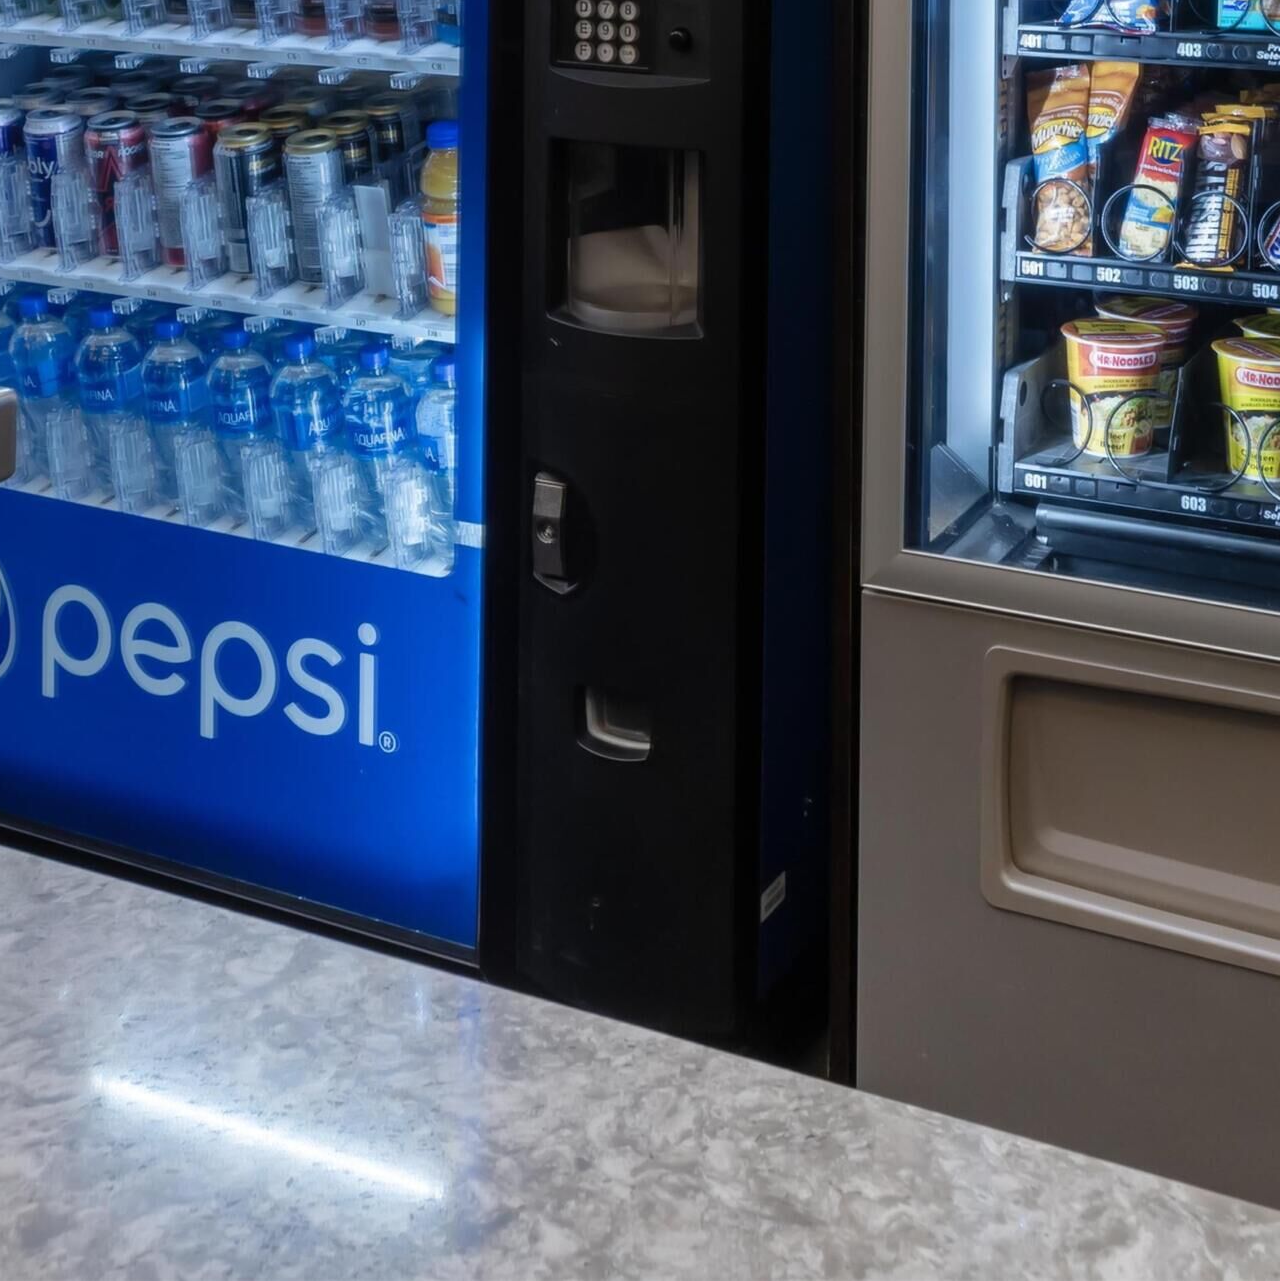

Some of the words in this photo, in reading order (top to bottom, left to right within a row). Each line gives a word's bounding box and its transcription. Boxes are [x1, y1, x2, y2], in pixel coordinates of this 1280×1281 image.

[580, 2, 588, 12] D
[602, 3, 610, 14] 7
[624, 5, 632, 16] 8
[580, 23, 588, 34] E
[602, 25, 610, 36] 9
[624, 26, 631, 38] 0
[1020, 33, 1041, 48] 401
[579, 44, 587, 55] F
[1177, 43, 1202, 57] 403
[1032, 118, 1084, 153] Munchies
[1148, 136, 1183, 162] RITZ
[1021, 261, 1043, 275] 501
[1097, 268, 1120, 283] 502
[1174, 276, 1199, 290] 503
[1253, 285, 1278, 299] 504
[1111, 354, 1155, 369] NOODLES
[1025, 474, 1047, 489] 601
[1181, 496, 1207, 511] 603
[41, 583, 382, 748] pepsi
